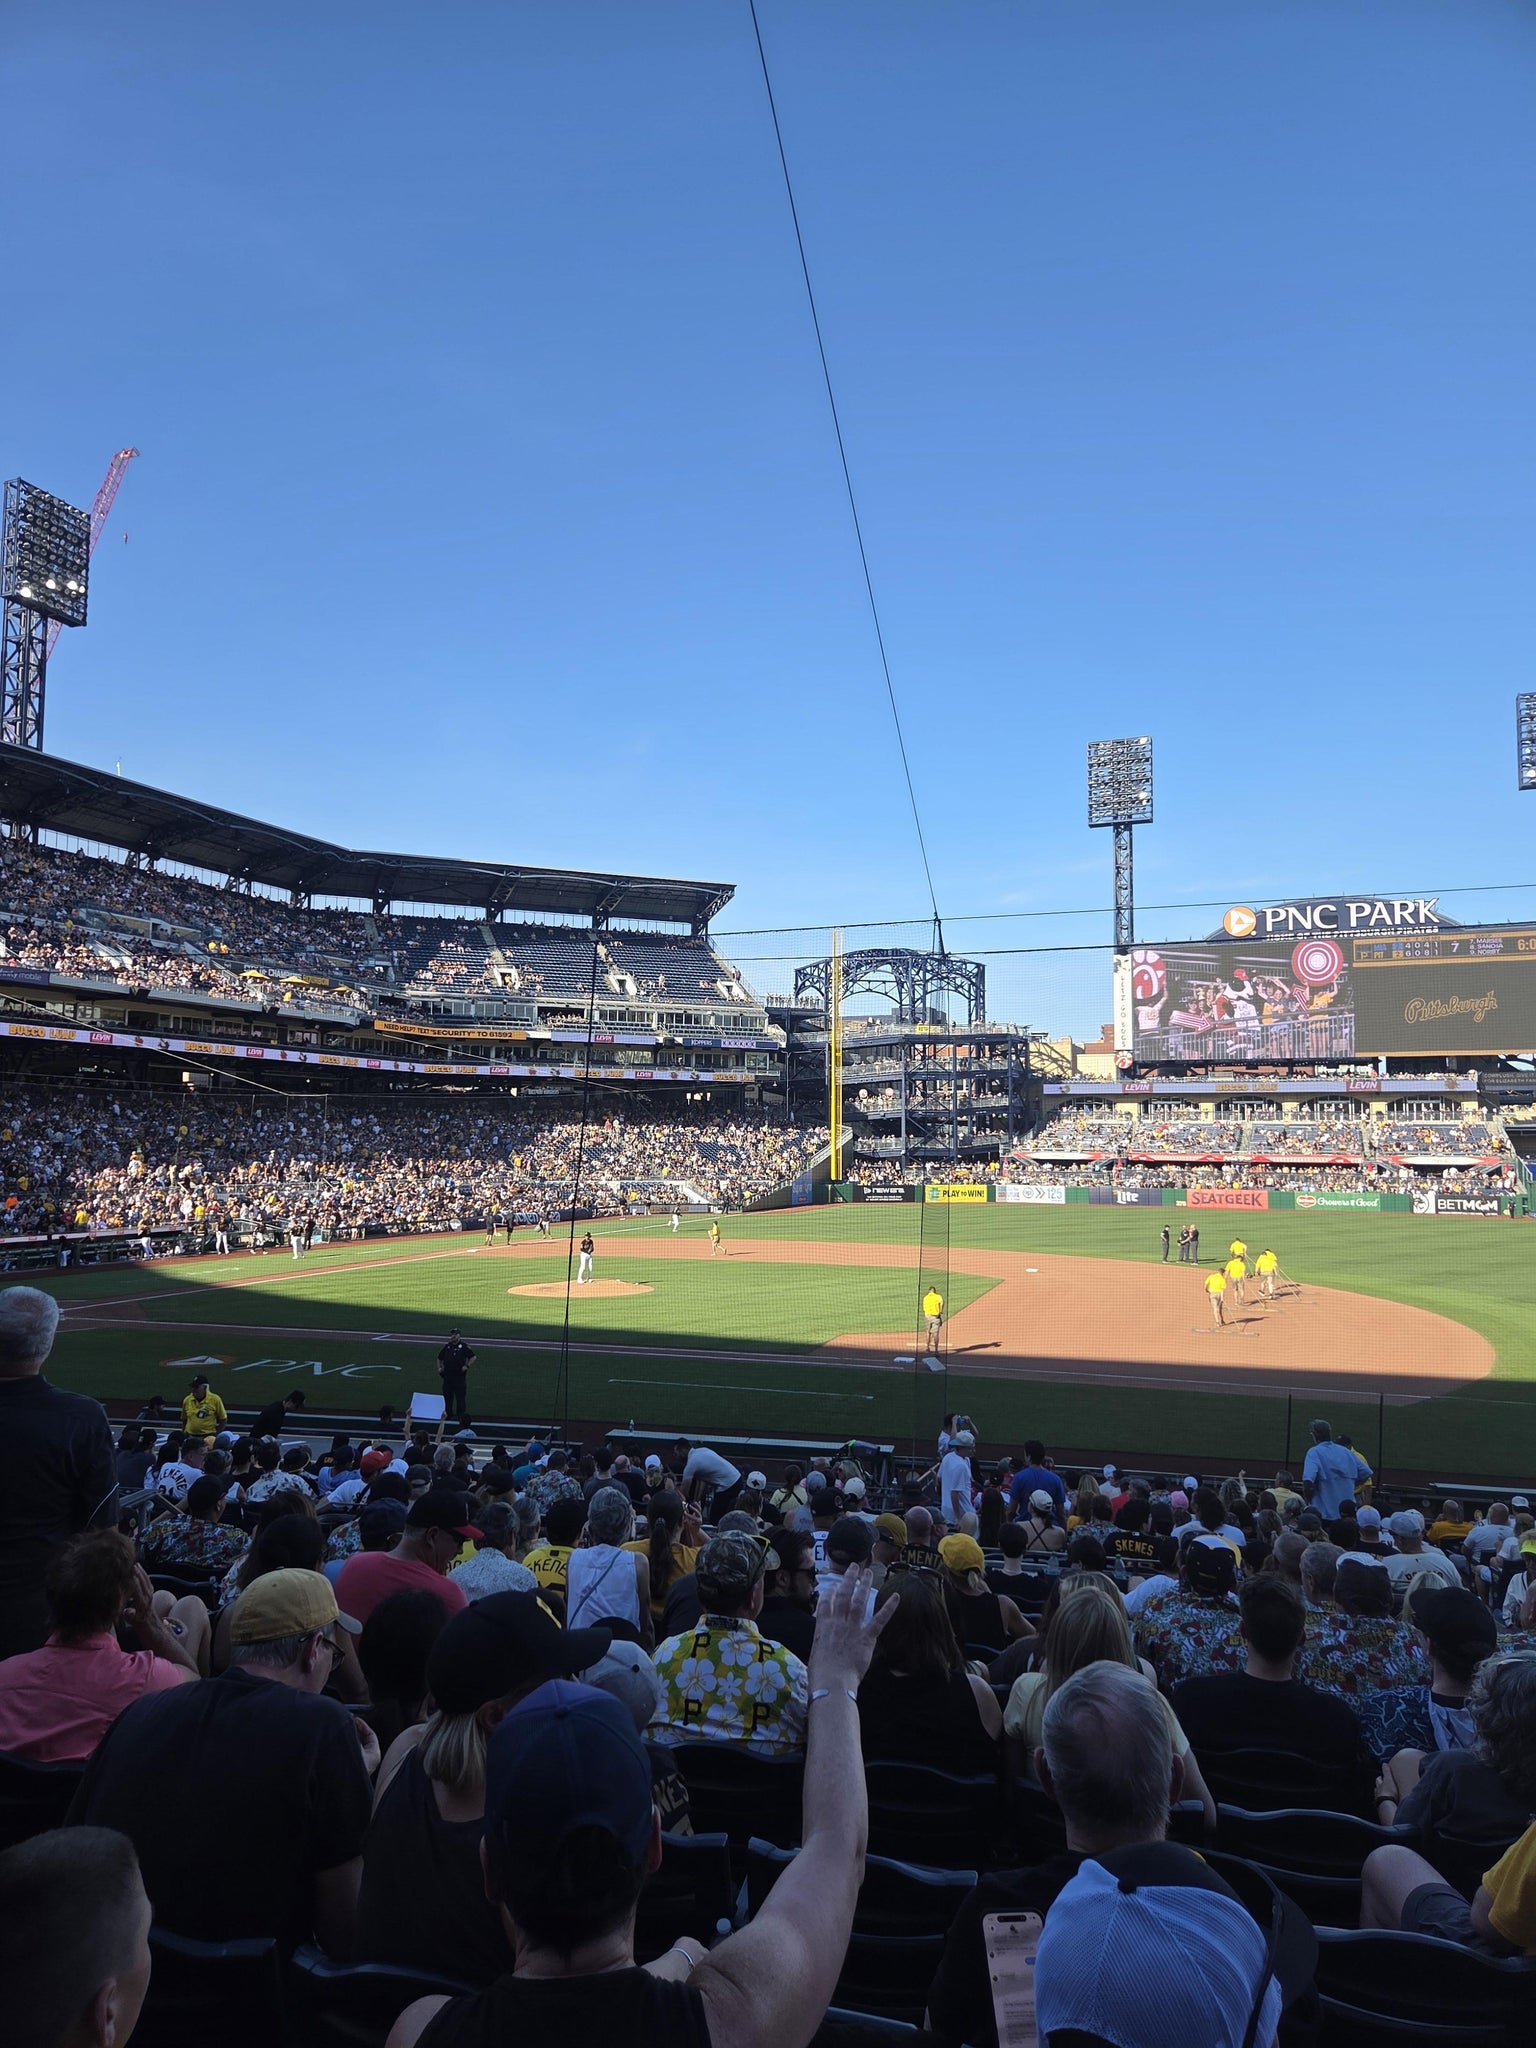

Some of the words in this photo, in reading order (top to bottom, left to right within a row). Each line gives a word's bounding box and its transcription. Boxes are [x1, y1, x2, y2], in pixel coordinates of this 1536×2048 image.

[1262, 904, 1338, 932] PNC
[1346, 897, 1440, 928] PARK
[1451, 943, 1460, 953] 7
[1405, 990, 1498, 1024] Pittsburgh
[9, 1024, 46, 1038] BUCCO
[49, 1028, 77, 1040] LUAU
[91, 1033, 111, 1041] LEVIN
[384, 1023, 400, 1031] NEED
[1349, 1081, 1378, 1090] LEVIN
[942, 1190, 959, 1198] PLAY
[967, 1190, 985, 1198] WIN!
[1047, 1187, 1063, 1199] 125
[1116, 1190, 1139, 1204] Lite
[1191, 1191, 1262, 1207] SEATGEEK
[1355, 1197, 1380, 1207] Good
[232, 1358, 402, 1378] PNC
[1114, 1538, 1155, 1557] SKENES
[690, 1632, 711, 1658] P
[758, 1641, 775, 1662] P
[683, 1699, 702, 1726] P
[752, 1702, 771, 1731] P
